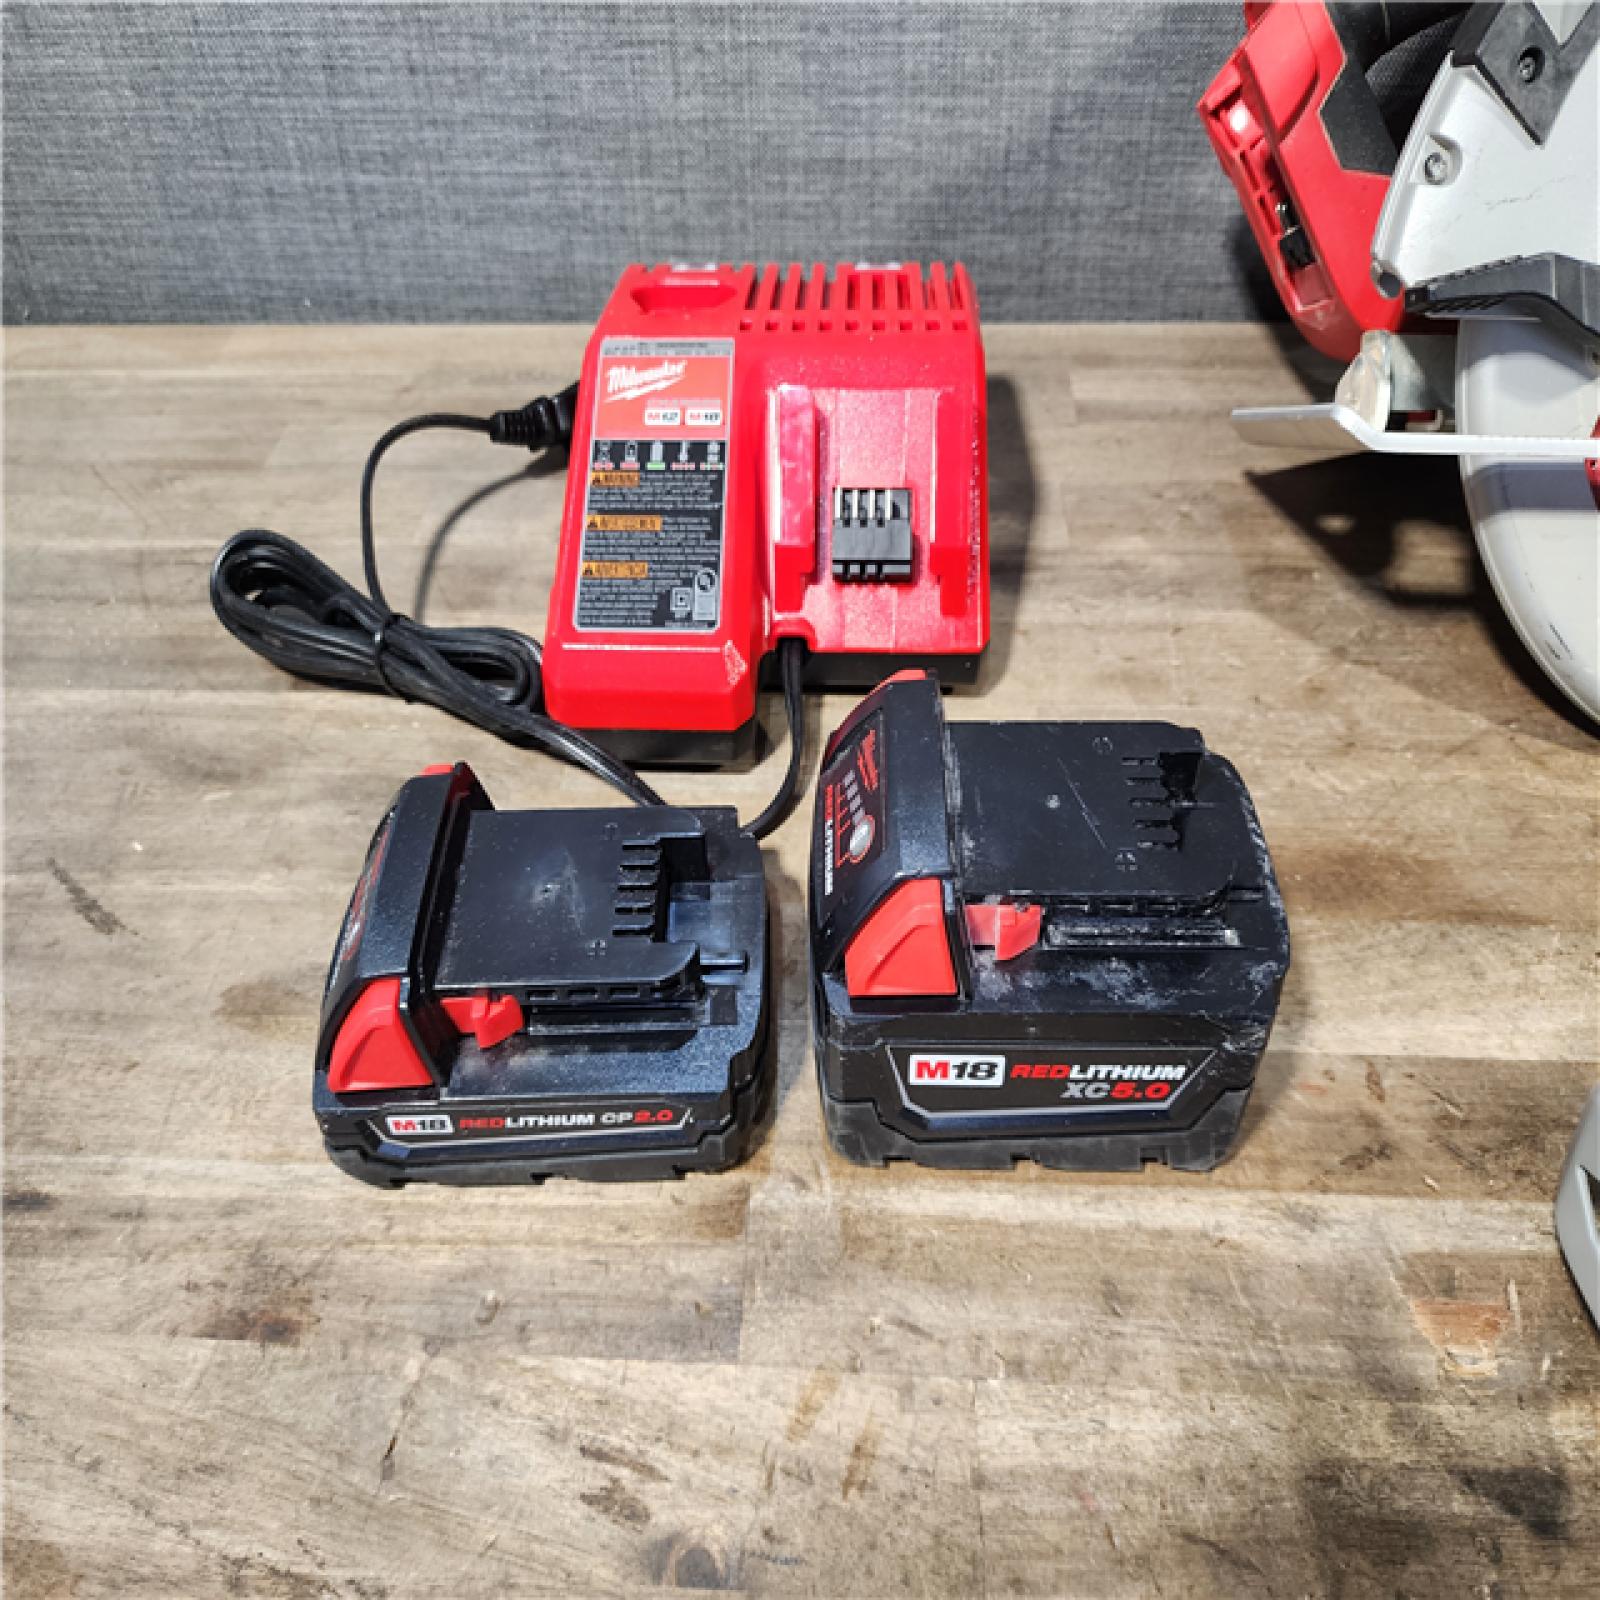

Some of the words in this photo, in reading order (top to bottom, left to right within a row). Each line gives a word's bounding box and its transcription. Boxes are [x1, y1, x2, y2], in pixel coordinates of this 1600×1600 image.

[914, 1059, 999, 1081] M18
[1010, 1063, 1187, 1081] REDLITHIUM
[391, 1118, 448, 1132] M18
[459, 1113, 596, 1129] REDLITHIUM
